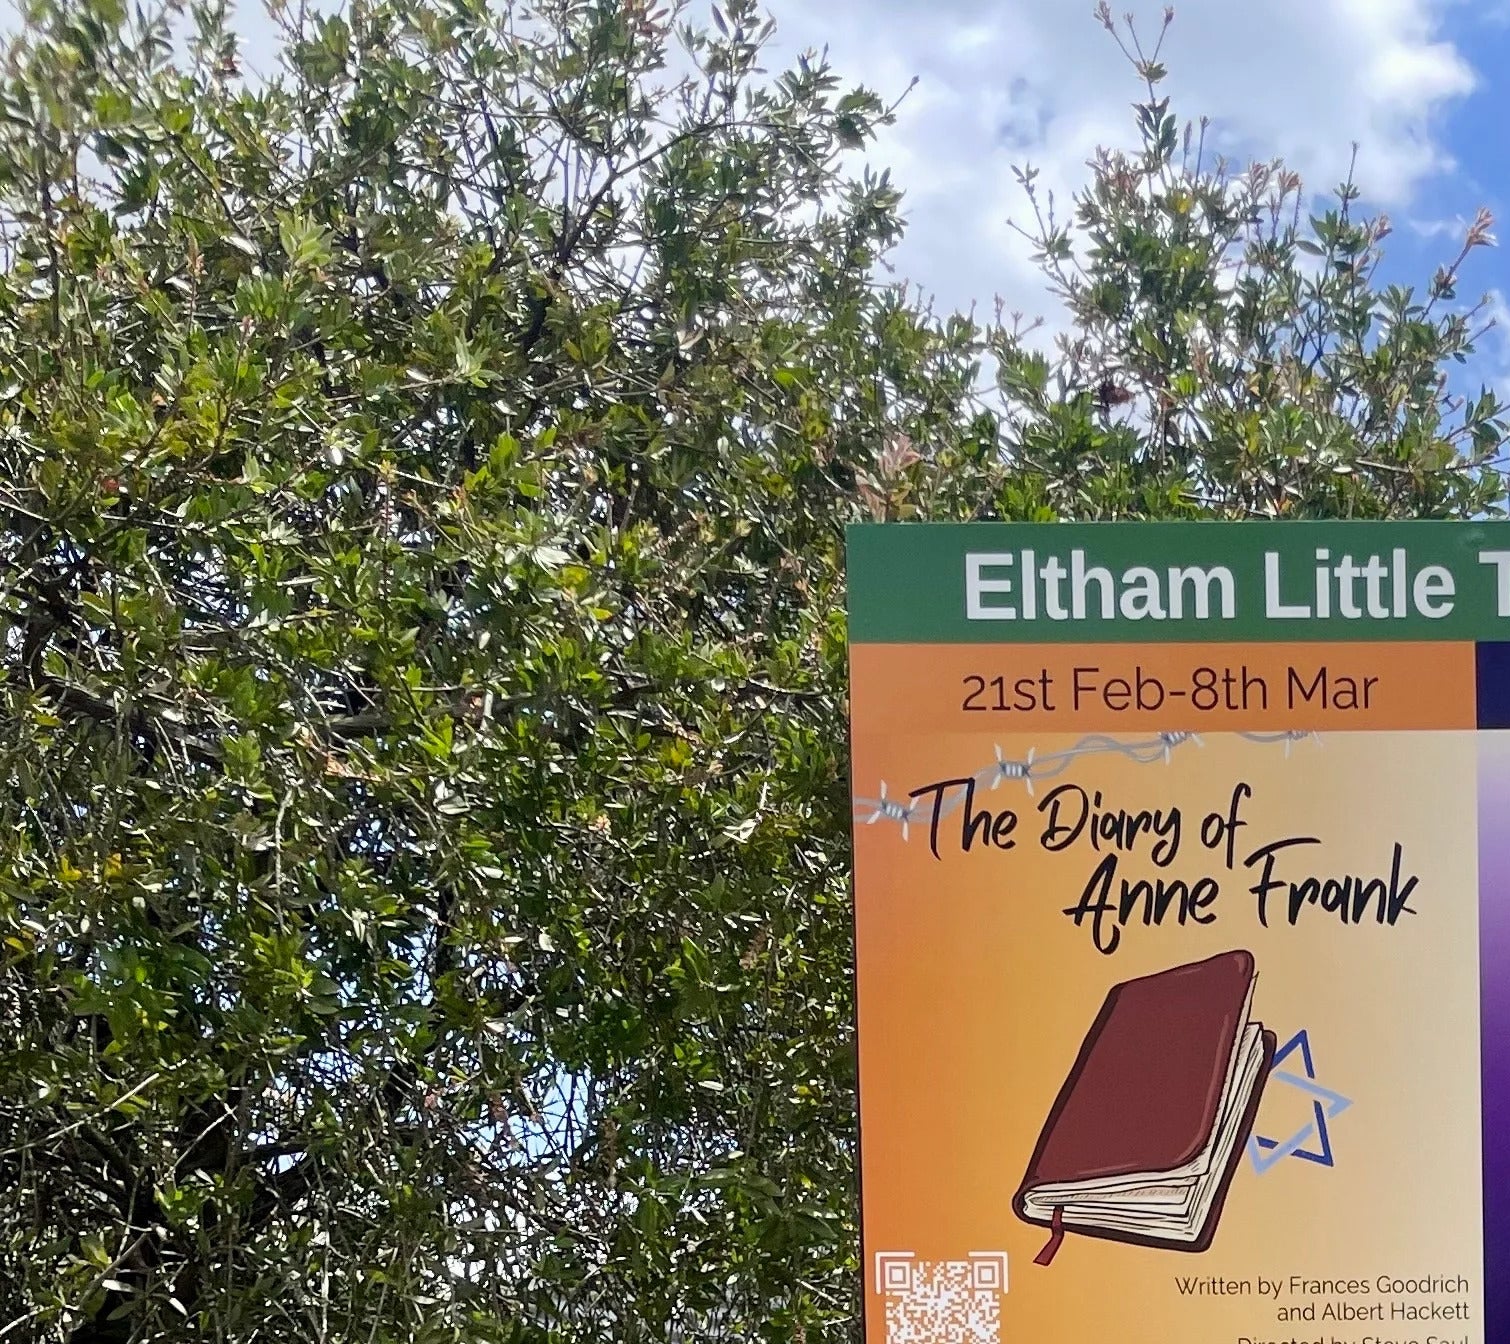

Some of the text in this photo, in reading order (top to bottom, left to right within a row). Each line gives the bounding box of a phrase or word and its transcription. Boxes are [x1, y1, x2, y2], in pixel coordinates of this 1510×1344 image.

[966, 549, 1235, 620] Eltham
[1265, 548, 1455, 618] Little
[963, 666, 1378, 711] 21st Feb-8th Mar
[908, 778, 1251, 869] The Diary of
[1062, 837, 1420, 954] Anne Frank
[1175, 1275, 1468, 1300] Written by Frances Goodrich
[1278, 1302, 1469, 1321] and Albert Hackett
